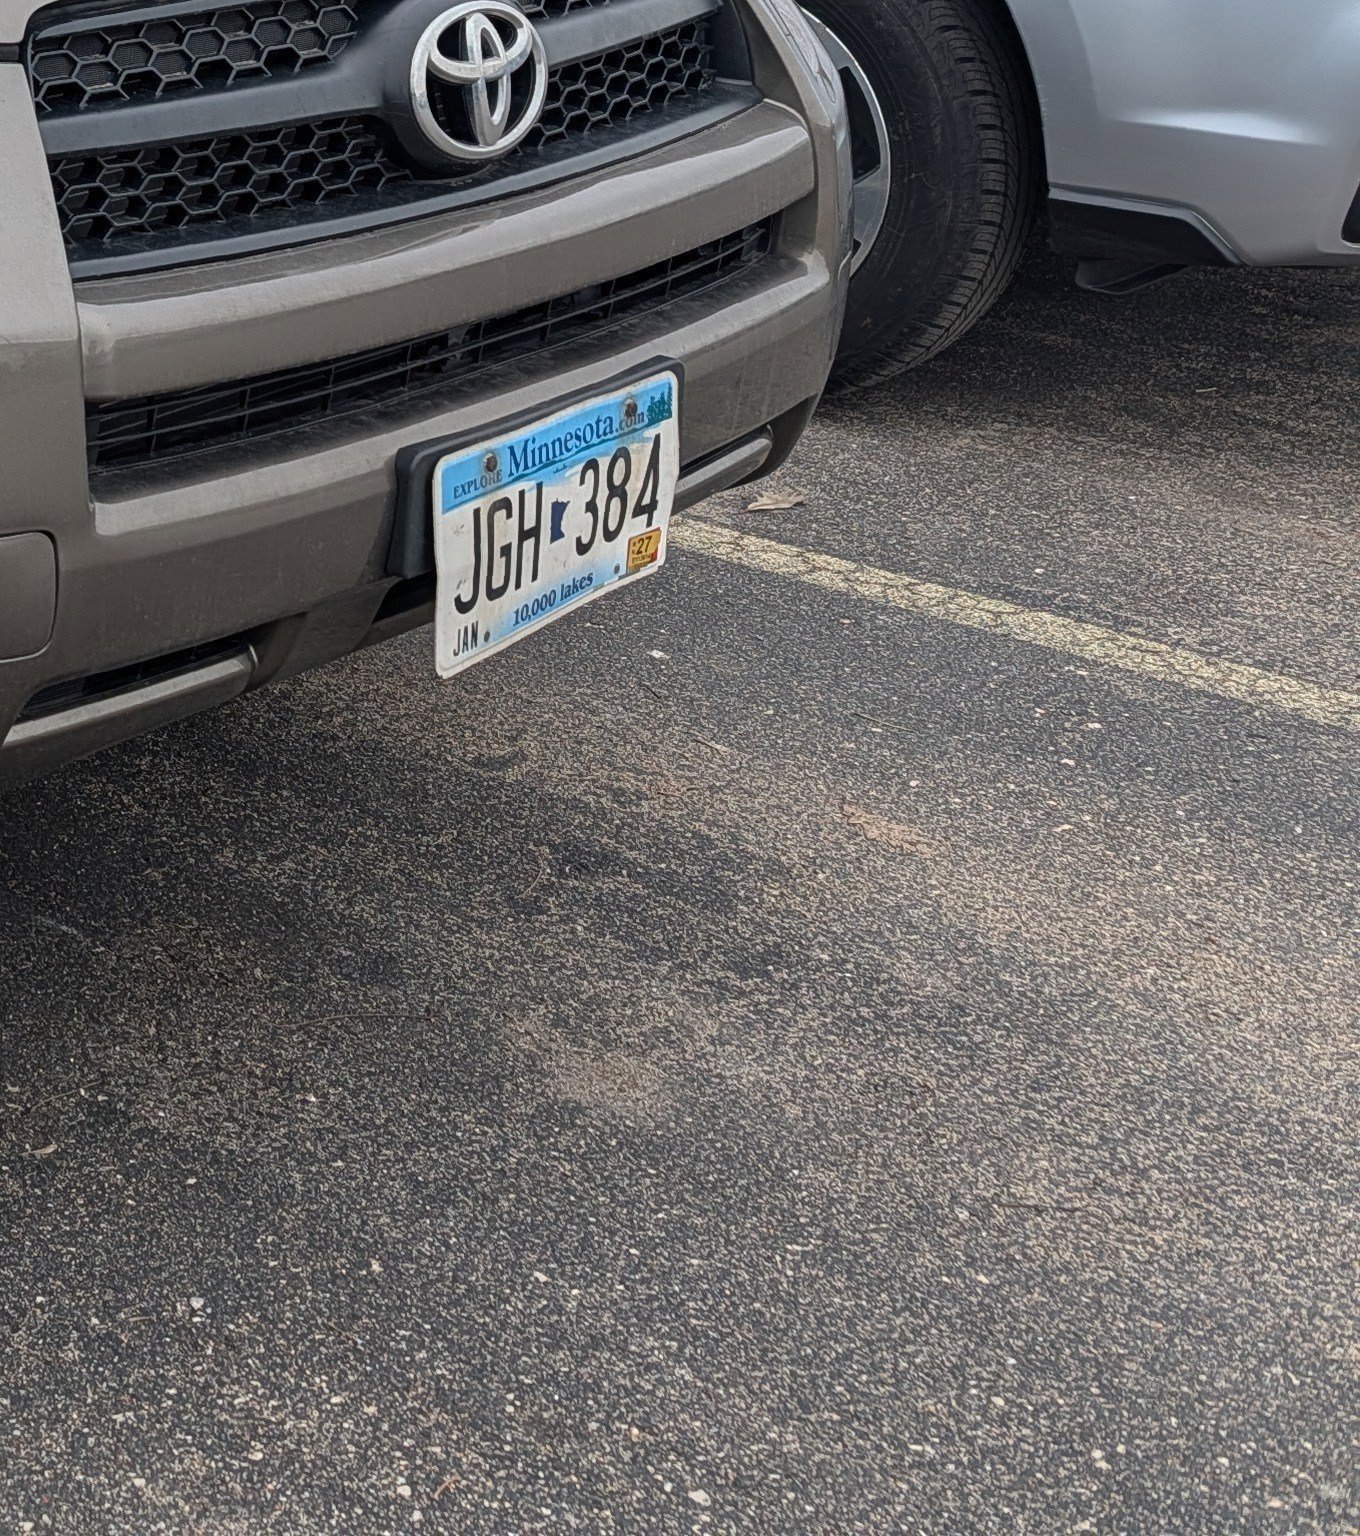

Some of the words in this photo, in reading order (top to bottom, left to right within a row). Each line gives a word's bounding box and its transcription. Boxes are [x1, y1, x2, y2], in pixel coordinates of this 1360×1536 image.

[453, 481, 544, 615] JGH
[574, 432, 662, 557] 384
[636, 535, 652, 555] 27
[512, 589, 557, 627] 10,000
[560, 572, 594, 602] lakes
[452, 620, 479, 657] JAN
